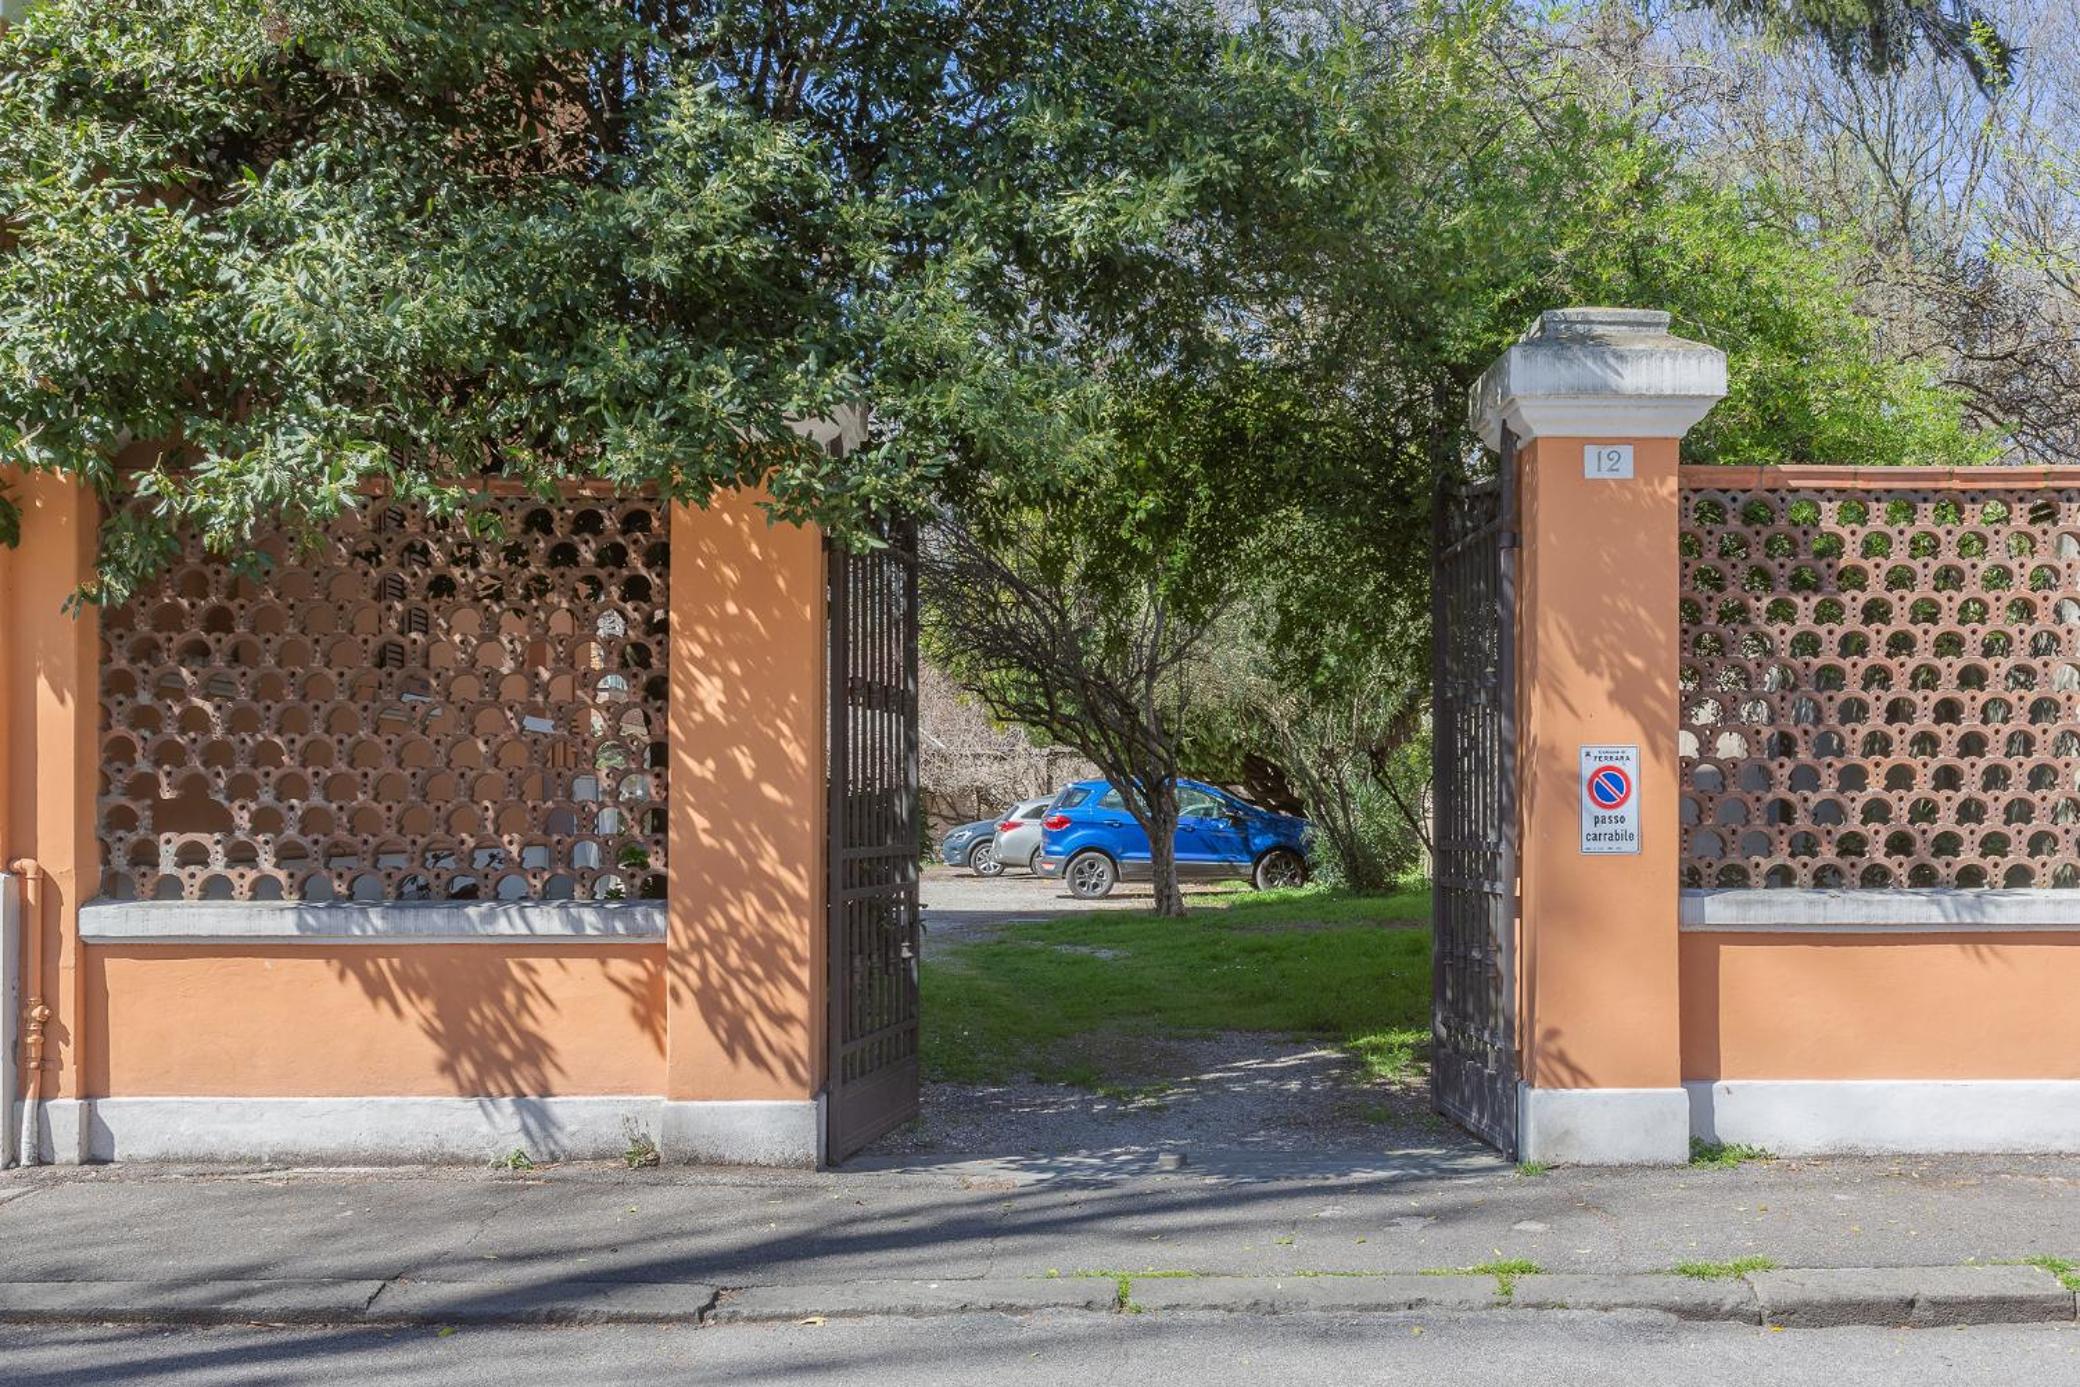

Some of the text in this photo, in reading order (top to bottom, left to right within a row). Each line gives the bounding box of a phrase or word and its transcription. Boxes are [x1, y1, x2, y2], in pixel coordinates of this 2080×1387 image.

[1597, 450, 1621, 472] 12
[1594, 814, 1626, 828] passo
[1586, 830, 1634, 842] carrabile
